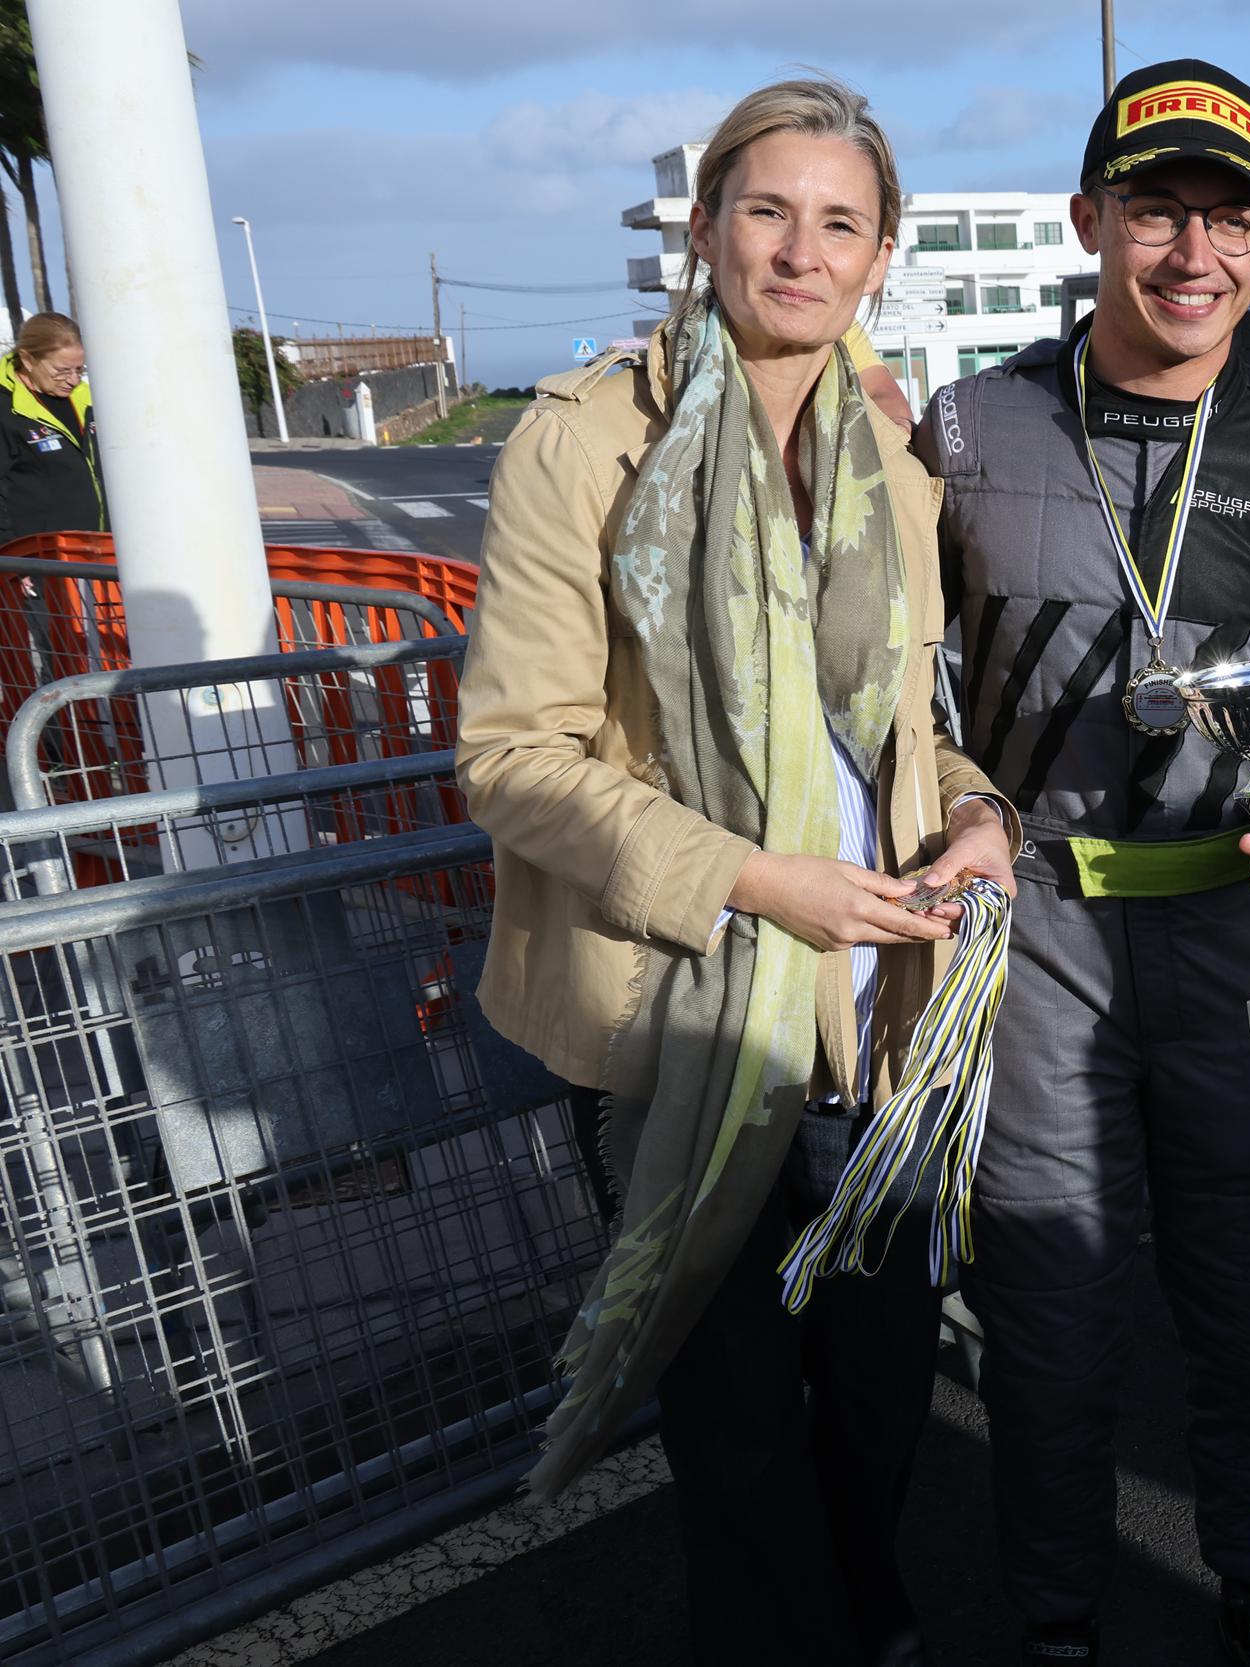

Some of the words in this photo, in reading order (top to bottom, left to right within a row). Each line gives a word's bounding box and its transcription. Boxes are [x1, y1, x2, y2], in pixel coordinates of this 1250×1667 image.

[937, 384, 965, 456] sparco
[1190, 498, 1247, 518] SPORT
[1144, 679, 1174, 689] FINISHE
